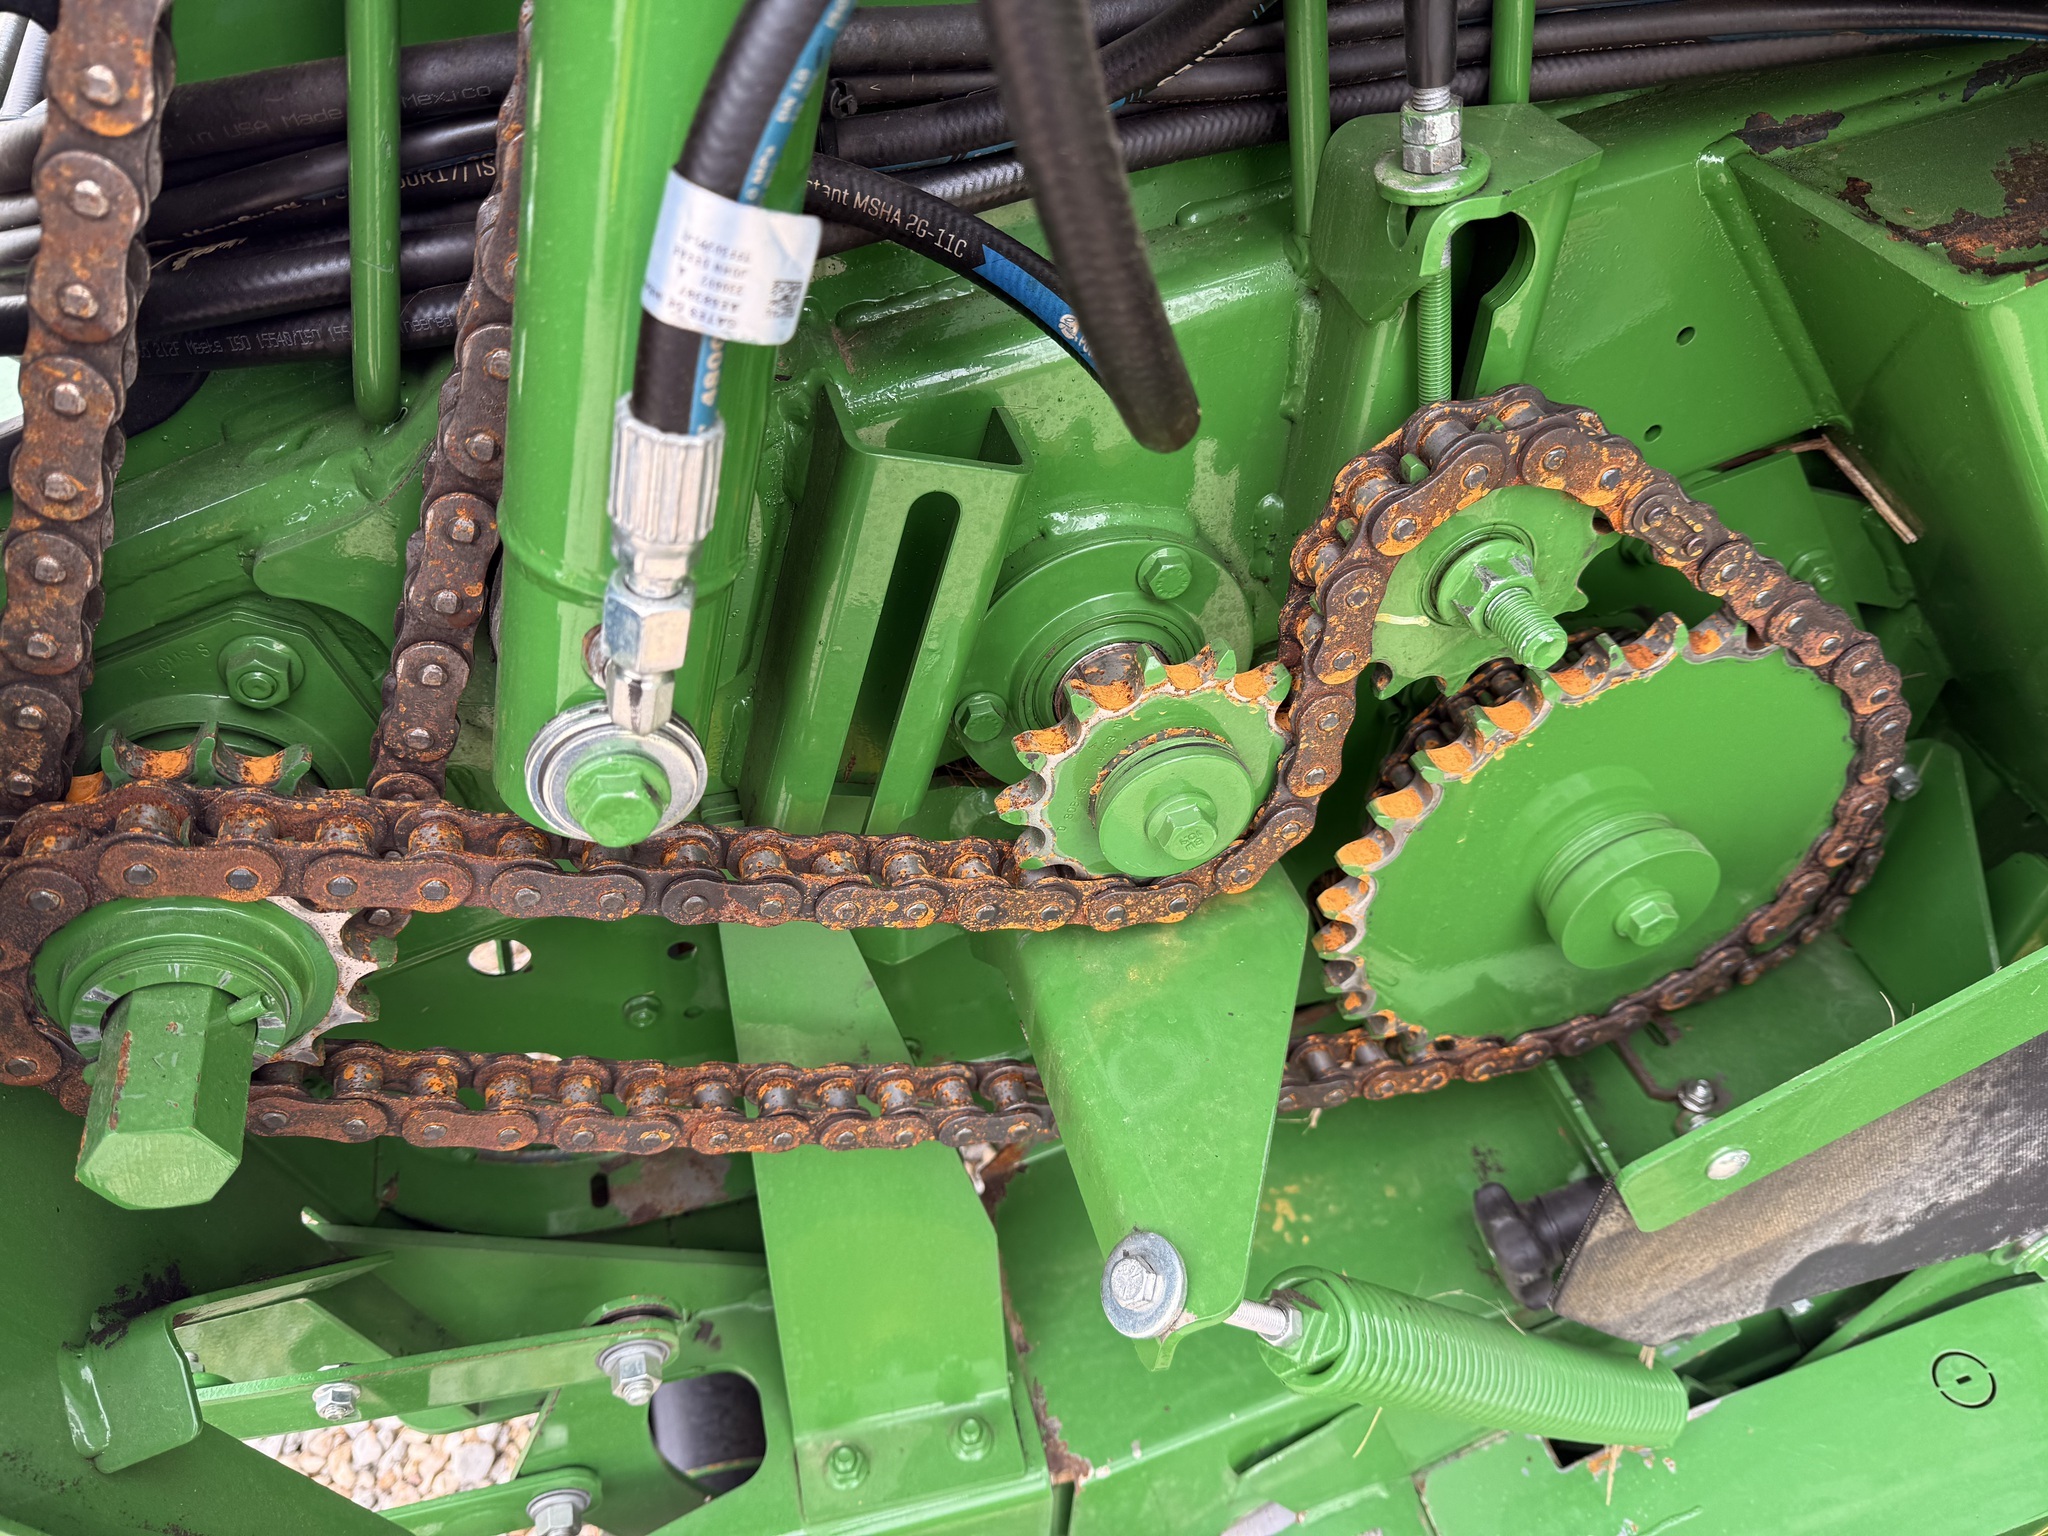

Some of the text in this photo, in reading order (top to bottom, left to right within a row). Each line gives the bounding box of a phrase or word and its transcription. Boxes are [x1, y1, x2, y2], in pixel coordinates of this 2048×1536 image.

[401, 86, 491, 108] Mexico
[223, 120, 270, 138] USA
[282, 108, 342, 129] Made
[853, 191, 901, 227] MSHA
[905, 213, 967, 258] 2G-11C
